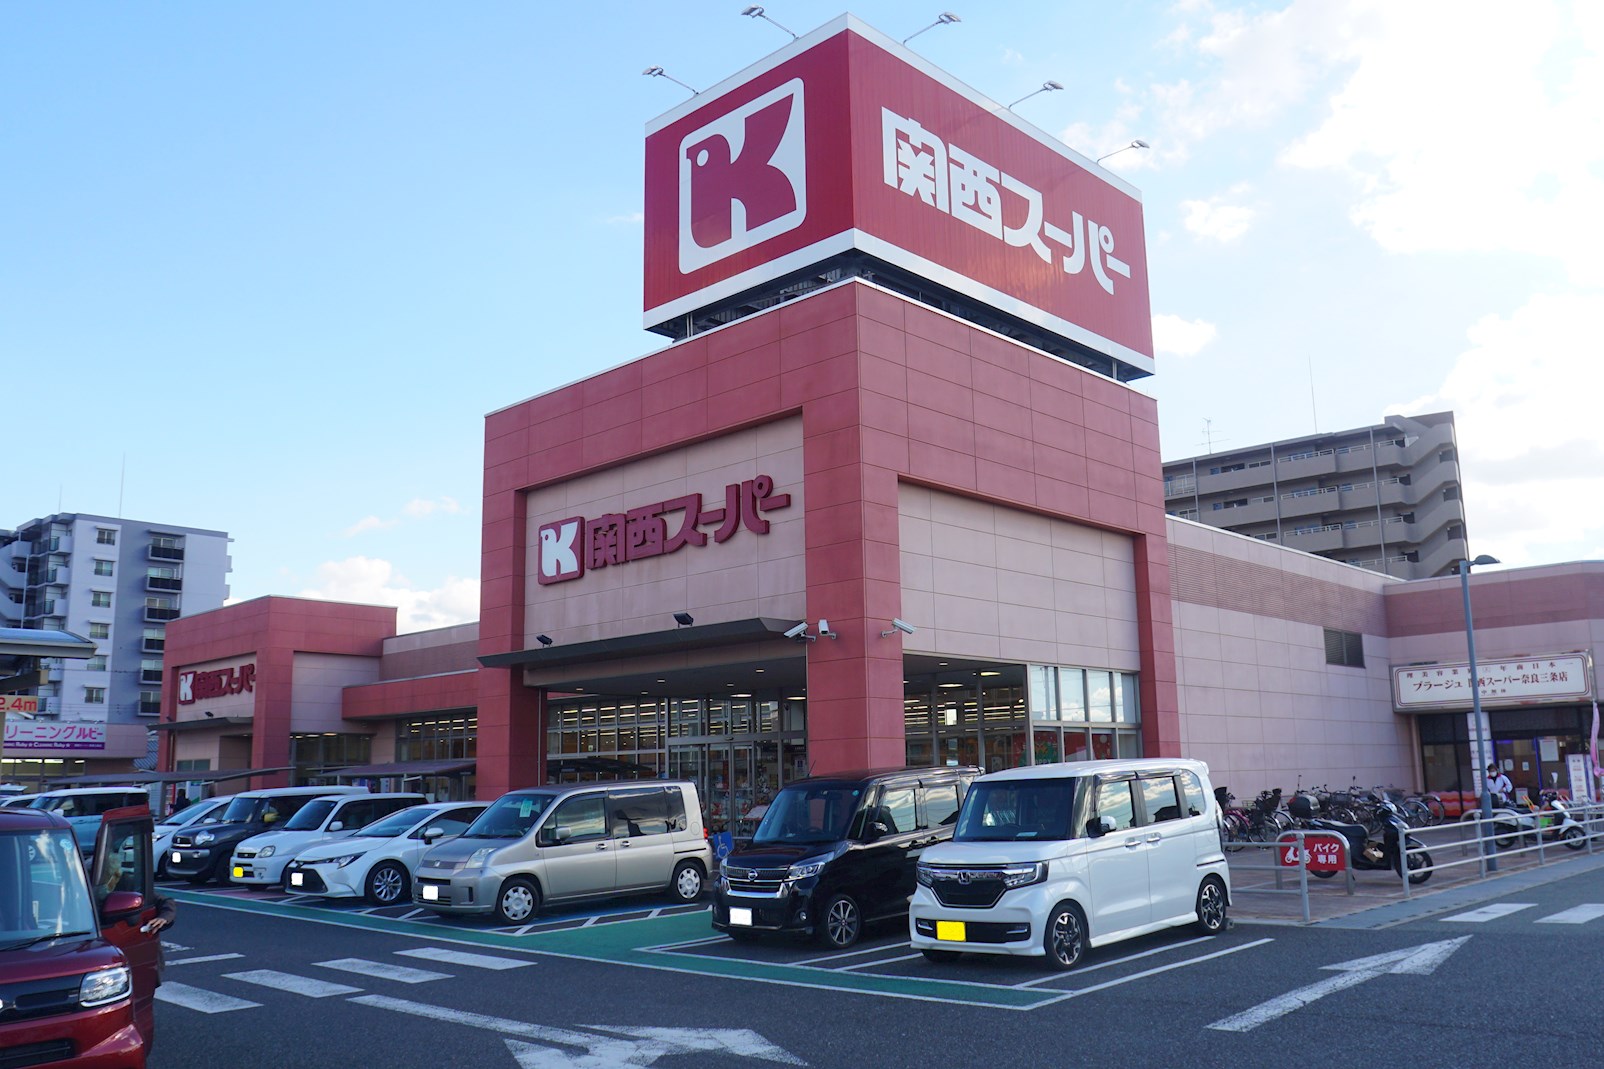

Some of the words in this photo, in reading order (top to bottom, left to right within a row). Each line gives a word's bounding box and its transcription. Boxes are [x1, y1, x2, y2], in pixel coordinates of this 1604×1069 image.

[881, 106, 1131, 295] 関西スーパー
[587, 475, 791, 570] 関西スーパー
[1313, 843, 1340, 853] バイク
[1317, 854, 1337, 864] 専用
